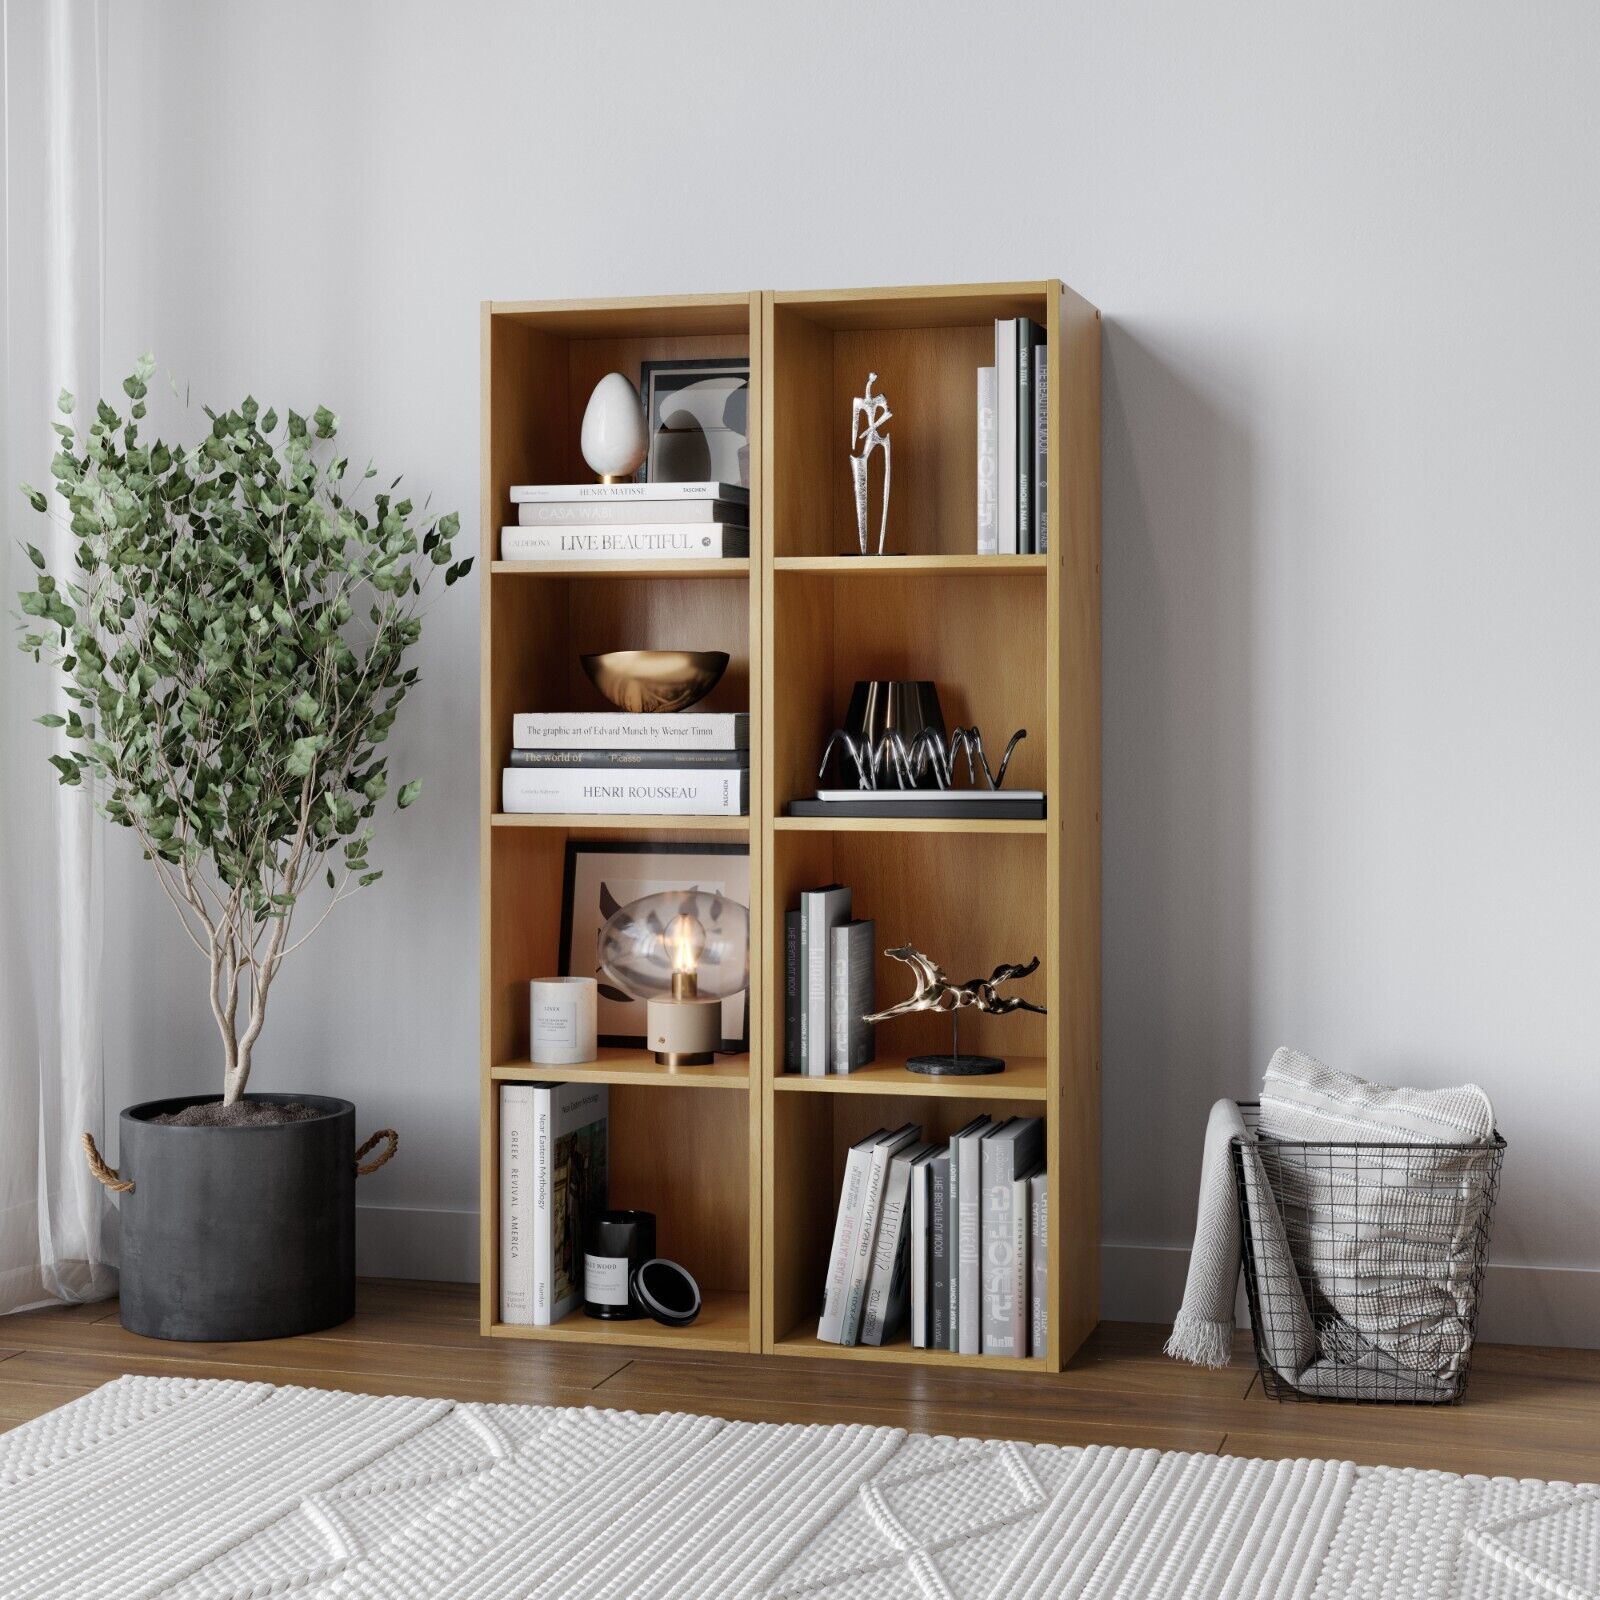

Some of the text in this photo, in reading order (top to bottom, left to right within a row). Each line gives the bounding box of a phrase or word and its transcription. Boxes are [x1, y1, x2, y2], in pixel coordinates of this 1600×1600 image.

[580, 487, 646, 496] HENRY MATISSE
[538, 508, 575, 520] CASA
[560, 534, 694, 550] LIVE BEAUTIFUL
[527, 726, 713, 738] The graphic art of Edvard Munch by Werner Timm
[524, 752, 583, 762] The world of
[611, 754, 641, 763] Picasso
[584, 787, 697, 799] HENRI ROUSSEAU
[512, 1168, 520, 1208] REVIVAL
[538, 1166, 546, 1210] Mythology
